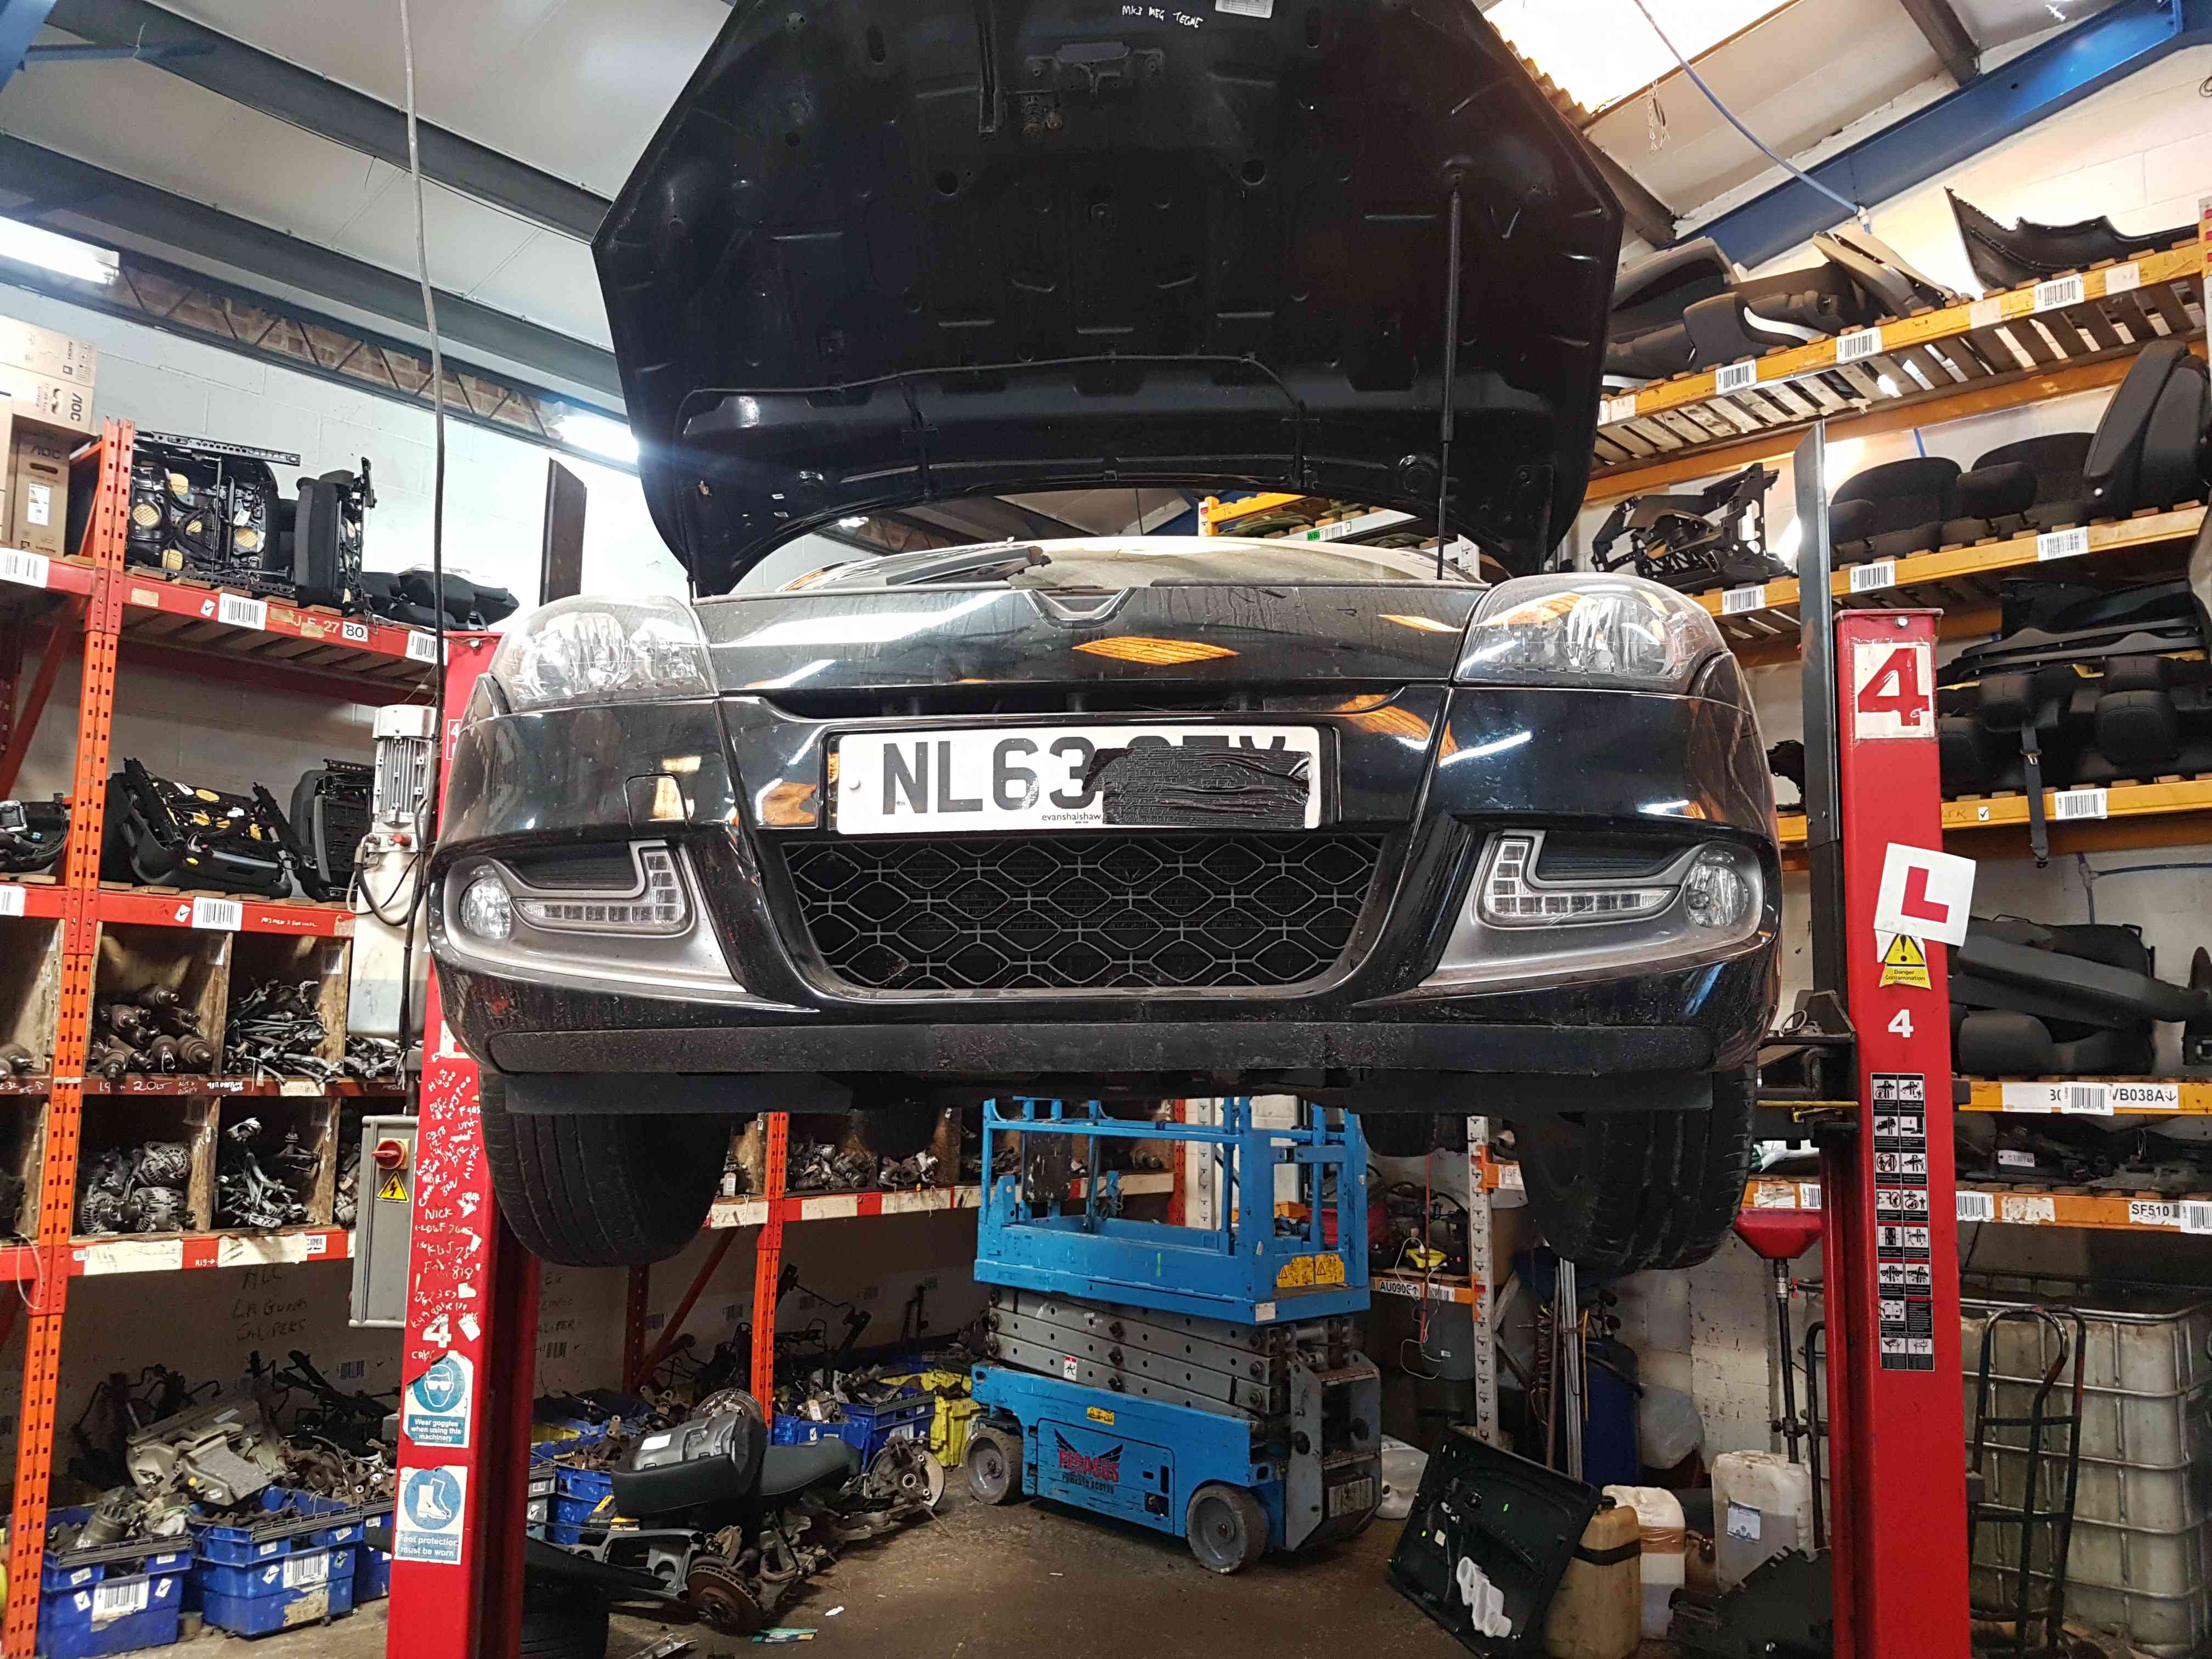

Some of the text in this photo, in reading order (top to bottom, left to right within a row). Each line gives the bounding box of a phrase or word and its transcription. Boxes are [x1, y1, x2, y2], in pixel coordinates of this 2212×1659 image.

[1149, 7, 1165, 21] MEG
[323, 620, 340, 633] 27
[1858, 647, 1930, 726] 4
[1901, 866, 1949, 923] L
[1888, 1009, 1914, 1037] 4
[425, 1207, 453, 1220] NICK
[2131, 1204, 2169, 1216] SF510
[422, 1313, 452, 1348] 4
[430, 1426, 448, 1435] using
[419, 1433, 452, 1442] machinery
[400, 1545, 455, 1557] must be worn
